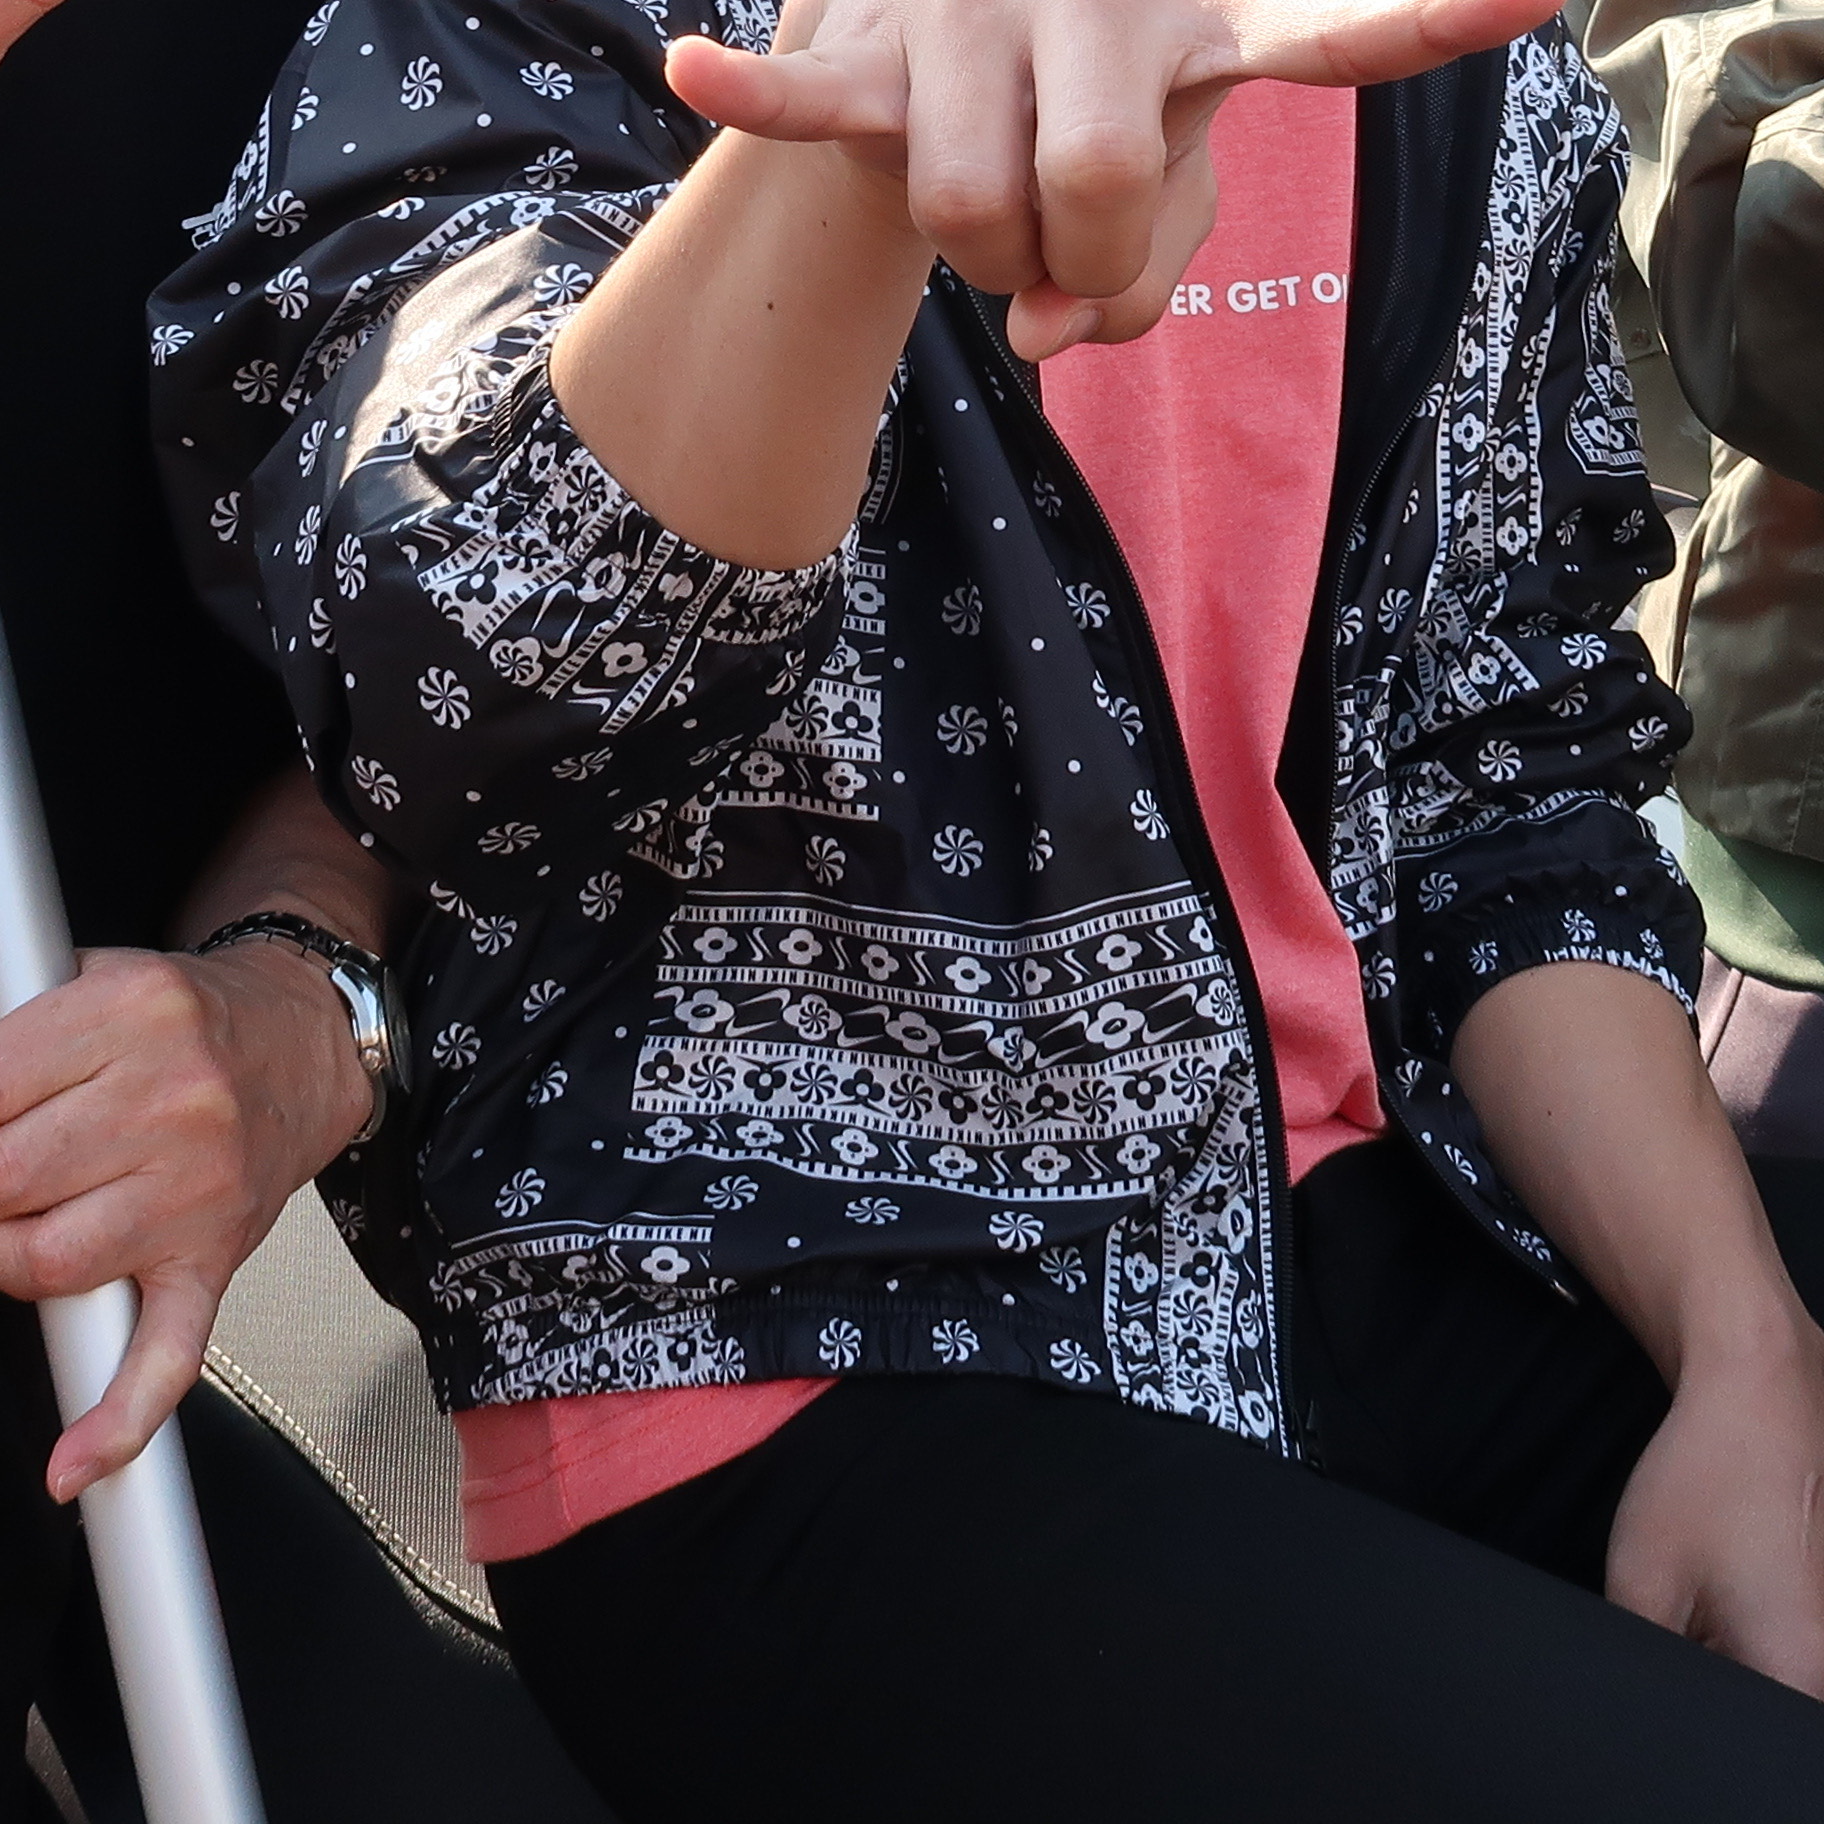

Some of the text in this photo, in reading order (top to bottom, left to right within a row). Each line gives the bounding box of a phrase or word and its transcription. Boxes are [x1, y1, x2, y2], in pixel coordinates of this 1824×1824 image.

[1226, 276, 1301, 314] GET
[845, 616, 878, 632] NIKE
[813, 678, 847, 697] NIKE
[828, 744, 864, 760] NIKE
[684, 907, 719, 921] NIKE
[725, 907, 758, 921] NIKE
[764, 907, 799, 923] NIKE
[805, 912, 833, 929] NIKE
[837, 914, 863, 935] NIKE
[869, 924, 902, 942] NIKE
[908, 928, 945, 947] NIKE
[951, 935, 986, 952] NIKE
[1036, 928, 1072, 952] NIKE
[1076, 916, 1110, 938] NIKE
[1115, 905, 1153, 929] NIKE
[682, 967, 717, 982] NIKE
[721, 967, 756, 981] NIKE
[761, 968, 797, 985] NIKE
[1131, 965, 1168, 988] NIKE
[1174, 959, 1209, 978] NIKE
[803, 972, 834, 989] NIKE
[838, 978, 868, 997] NIKE
[1092, 974, 1128, 1000] NIKE
[872, 984, 904, 1003] NIKE
[908, 990, 943, 1010] NIKE
[1052, 988, 1089, 1011] NIKE
[948, 996, 984, 1014] NIKE
[679, 1037, 715, 1052] NIKE
[721, 1039, 757, 1055] NIKE
[764, 1042, 800, 1059] NIKE
[807, 1046, 843, 1062] NIKE
[849, 1051, 884, 1068] NIKE
[889, 1056, 922, 1074] NIKE
[927, 1063, 957, 1080] NIKE
[1001, 1075, 1031, 1089] NIKE
[1037, 1065, 1074, 1084] NIKE
[1080, 1055, 1113, 1075] NIKE
[1118, 1045, 1155, 1067] NIKE
[1160, 1038, 1196, 1059] NIKE
[651, 1099, 1186, 1145] NIKE NIKE NIKE NIKE NIKE NIKE NIKE NIKE NIKE NIKE NIKE NIKE NIKE
